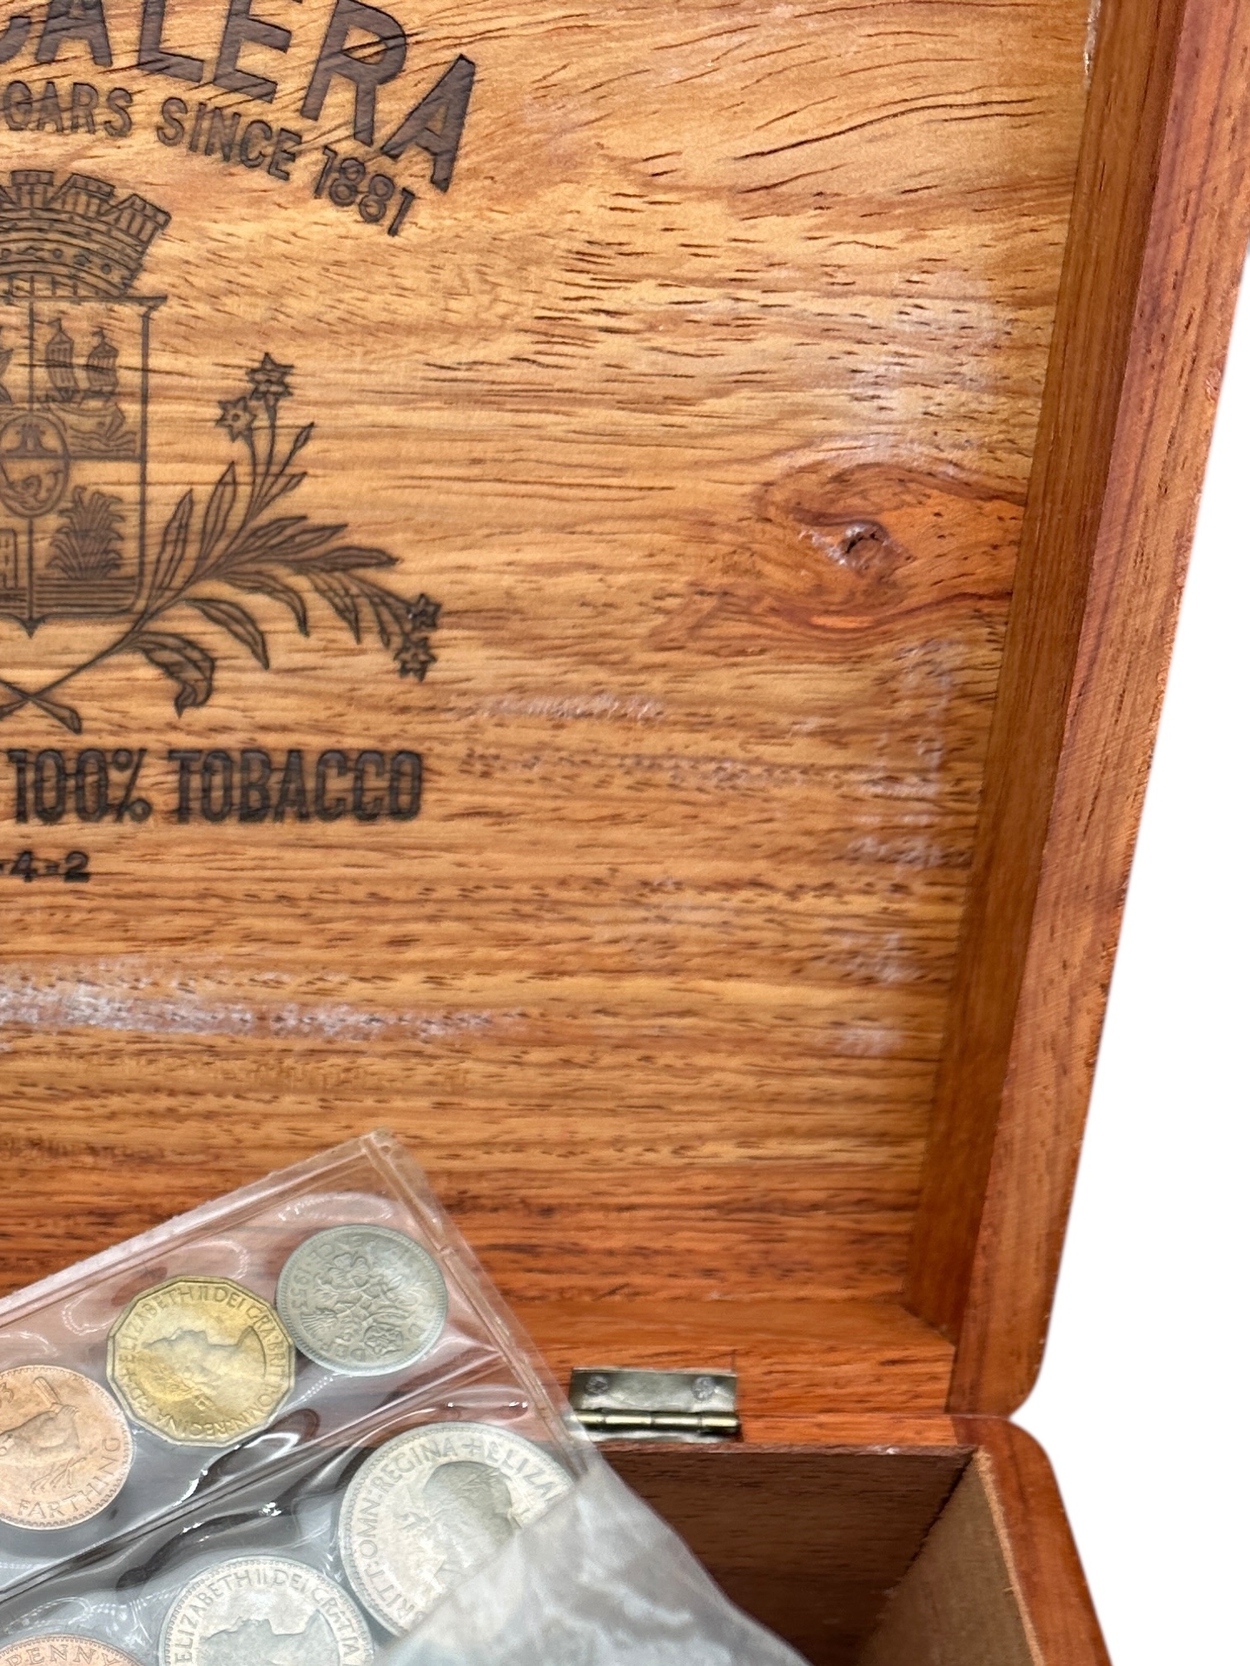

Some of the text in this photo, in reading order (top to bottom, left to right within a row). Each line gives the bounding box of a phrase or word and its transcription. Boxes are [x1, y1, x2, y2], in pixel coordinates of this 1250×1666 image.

[156, 97, 302, 181] SINCE
[314, 146, 416, 236] 1881
[7, 748, 153, 825] 100%
[167, 750, 423, 825] TOBACCO
[118, 1287, 195, 1362] ELIZABETH
[211, 1287, 243, 1311] DEI
[17, 1437, 121, 1520] FARTHING
[485, 1440, 560, 1502] ELIZA
[175, 1570, 252, 1663] ELIZABETH
[273, 1569, 310, 1593] DEI
